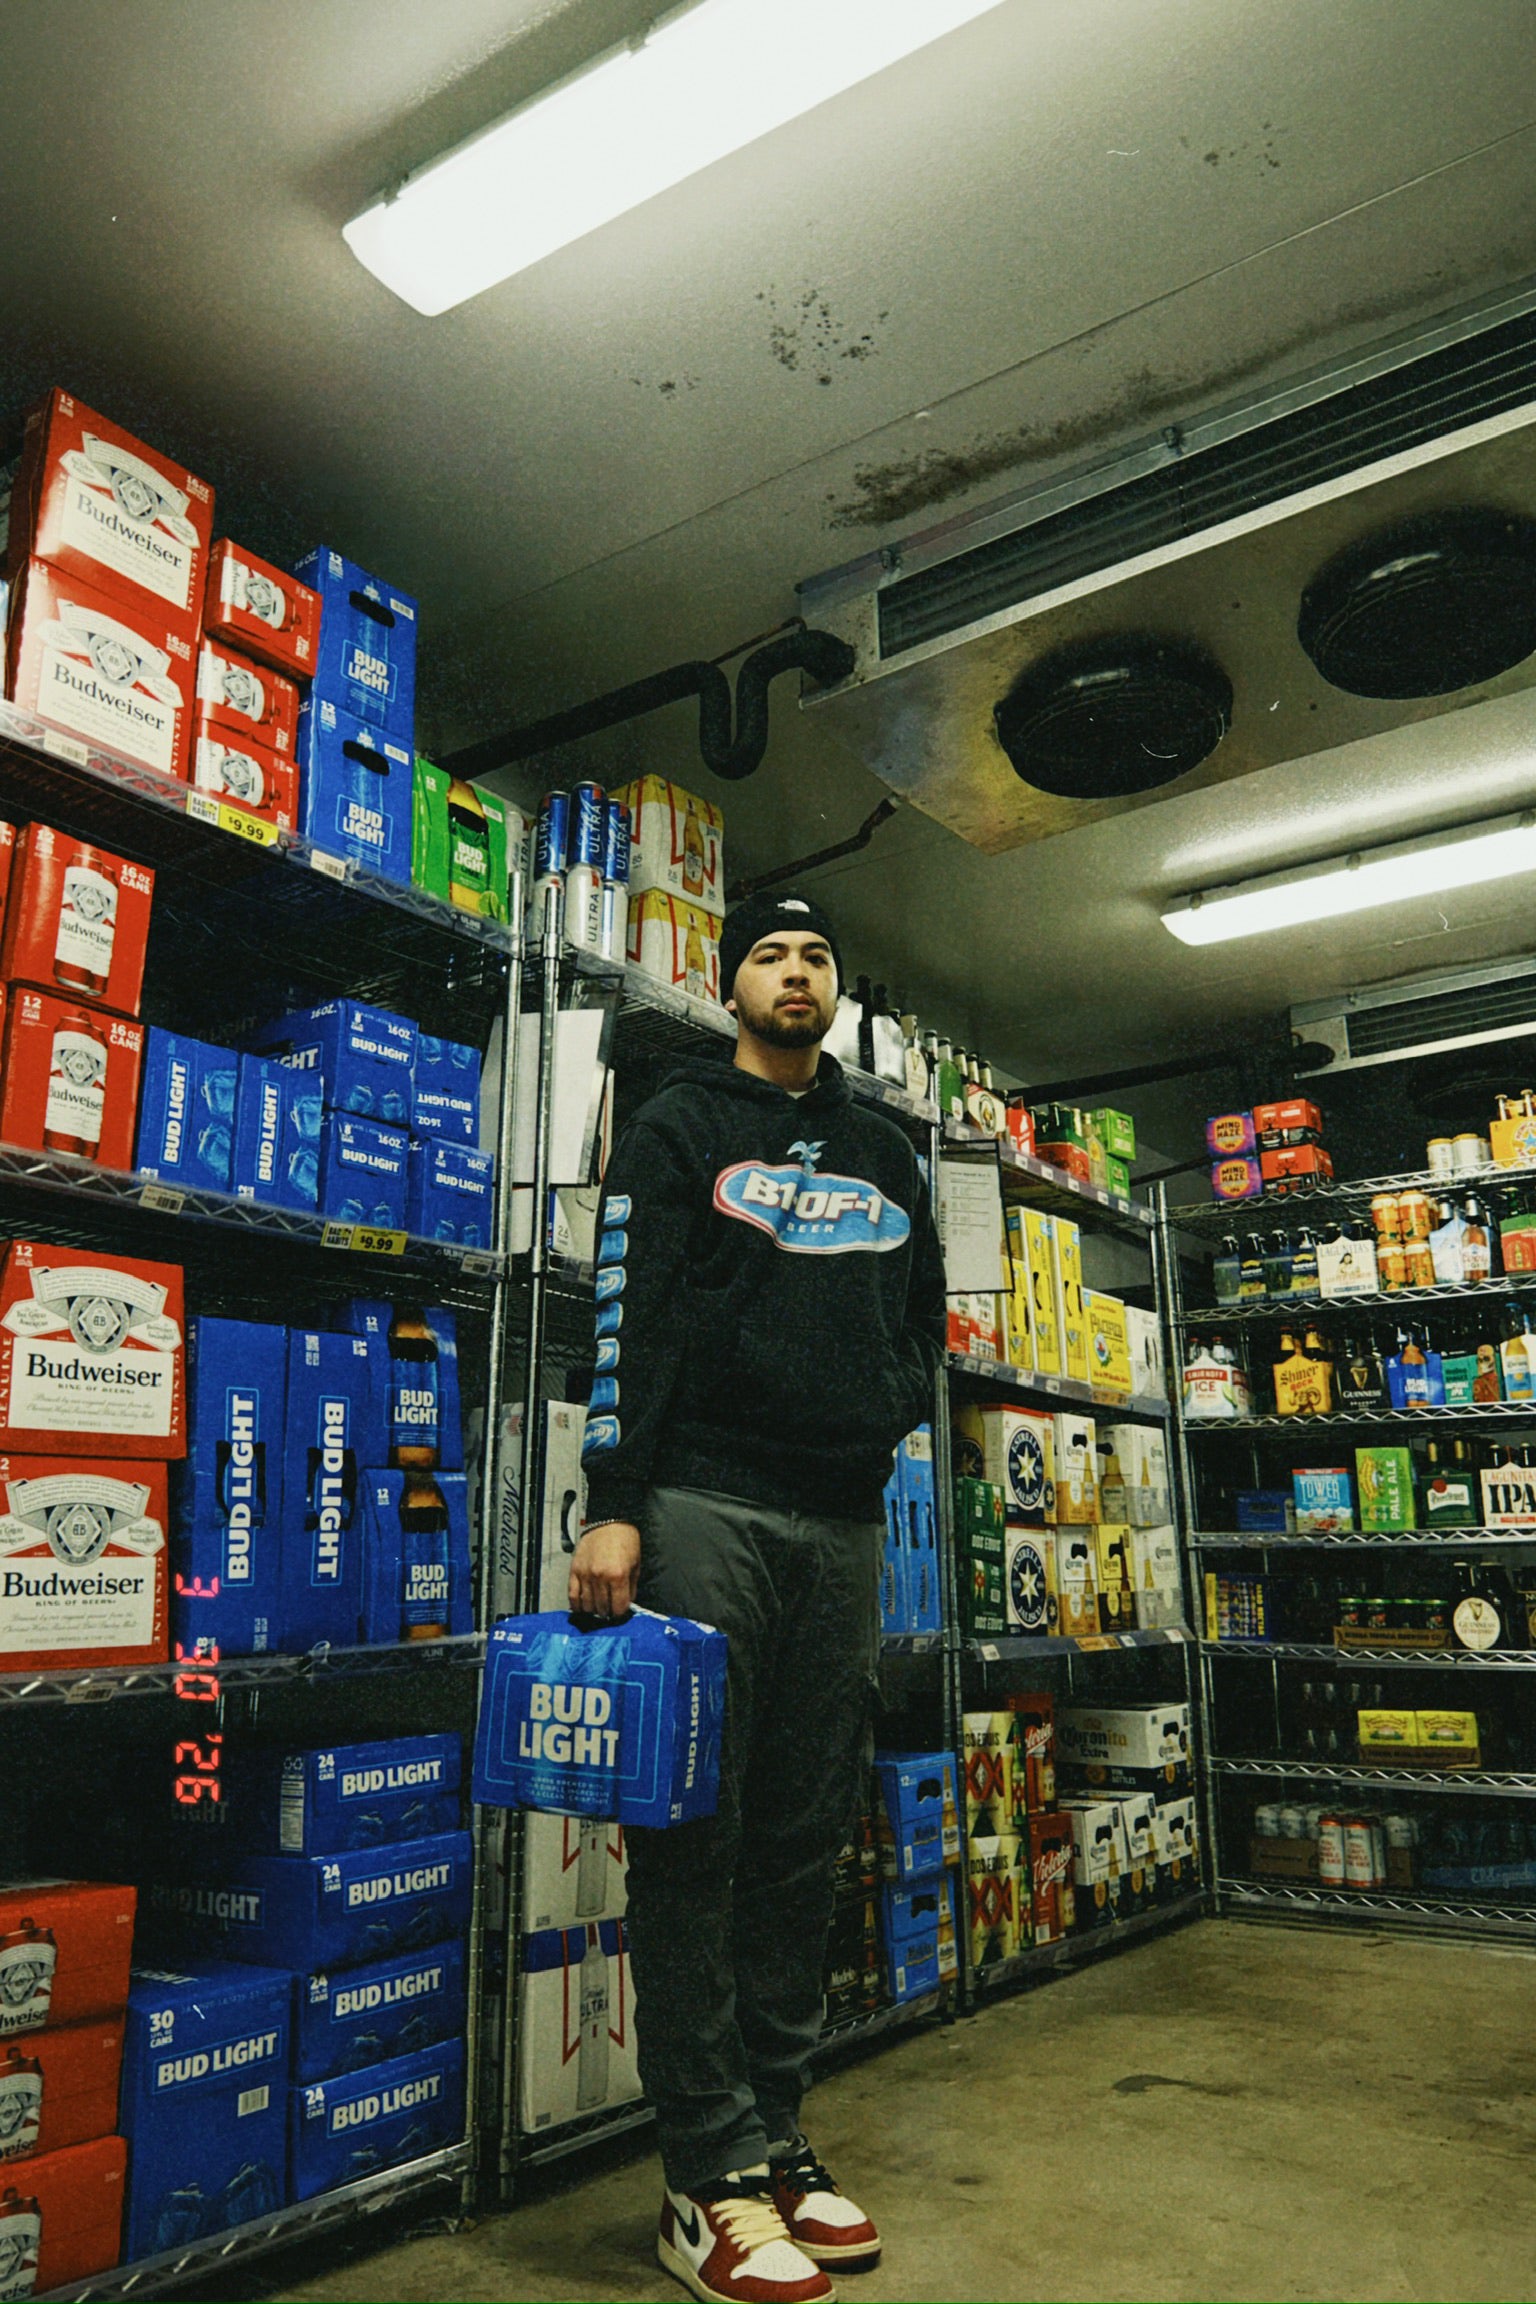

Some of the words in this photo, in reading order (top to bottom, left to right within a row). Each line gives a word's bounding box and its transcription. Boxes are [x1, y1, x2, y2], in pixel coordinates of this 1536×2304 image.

[77, 494, 182, 569] Budweiser
[329, 551, 342, 563] 12
[354, 648, 387, 677] BUD
[348, 661, 390, 695] LIGHT
[53, 662, 164, 730] Budweiser
[348, 802, 383, 828] BUD
[228, 816, 264, 840] $9.99
[342, 816, 385, 847] LIGHT
[537, 811, 550, 861] ULTRA
[588, 805, 602, 853] ULTRA
[458, 841, 483, 861] BUD
[616, 822, 628, 870] ULTRA
[121, 864, 137, 878] 16
[138, 873, 151, 884] OZ
[454, 850, 487, 875] LIGHT
[120, 876, 150, 895] CANS
[588, 893, 600, 942] ULTRA
[23, 995, 42, 1009] 12
[354, 1011, 362, 1023] 8
[109, 1034, 141, 1052] CANS
[111, 1022, 127, 1037] 16
[128, 1030, 141, 1041] OZ
[351, 1037, 378, 1053] BUD
[377, 1044, 410, 1063] LIGHT
[168, 1061, 187, 1120] LIGHT
[417, 1093, 449, 1107] LIGHT
[261, 1085, 278, 1140] LIGHT
[450, 1101, 472, 1112] BUD
[343, 1124, 352, 1135] 8
[1217, 1121, 1240, 1131] MIND
[1217, 1129, 1240, 1138] HAZE
[163, 1120, 182, 1163] BUD
[258, 1141, 274, 1181] BUD
[342, 1148, 367, 1164] BUD
[367, 1155, 399, 1173] LIGHT
[1222, 1166, 1245, 1175] MIND
[435, 1172, 458, 1187] BUD
[458, 1177, 485, 1194] LIGHT
[1222, 1174, 1245, 1183] HAZE
[786, 1222, 835, 1233] BEER
[15, 1244, 33, 1257] 12
[359, 1235, 393, 1251] $9.99
[366, 1316, 377, 1325] 12
[26, 1353, 162, 1388] Budweiser
[1281, 1365, 1318, 1385] Shiner
[400, 1389, 434, 1407] BUD
[1194, 1381, 1216, 1392] ICE
[1343, 1389, 1382, 1398] GUINNESS
[394, 1406, 438, 1425] LIGHT
[232, 1394, 254, 1497] LIGHT
[322, 1402, 345, 1472] BUD
[1386, 1459, 1398, 1484] ALE
[377, 1488, 388, 1499] 12
[1388, 1487, 1400, 1520] PALE
[1488, 1483, 1536, 1513] IPA
[317, 1477, 343, 1579] LIGHT
[500, 1465, 521, 1576] Michelob
[229, 1502, 251, 1580] BUD
[2, 1572, 144, 1597] Budweiser
[411, 1564, 445, 1582] BUD
[405, 1582, 449, 1600] LIGHT
[493, 1630, 506, 1641] 12
[529, 1683, 611, 1726] BUD
[690, 1673, 701, 1738] LIGHT
[519, 1721, 619, 1767] LIGHT
[318, 1754, 335, 1768] 24
[685, 1741, 698, 1789] BUD
[342, 1771, 385, 1796] BUD
[387, 1760, 441, 1789] LIGHT
[322, 1864, 341, 1879] 24
[348, 1877, 392, 1906] BUD
[394, 1864, 450, 1895] LIGHT
[198, 1890, 260, 1921] LIGHT
[310, 1974, 328, 1990] 24
[336, 1985, 381, 2016] BUD
[384, 1968, 441, 2002] LIGHT
[150, 2009, 174, 2032] 30
[150, 2035, 173, 2048] CANS
[158, 2053, 209, 2087] BUD
[213, 2032, 277, 2071] LIGHT
[305, 2086, 325, 2105] 24
[332, 2096, 380, 2130] BUD
[382, 2075, 440, 2114] LIGHT
